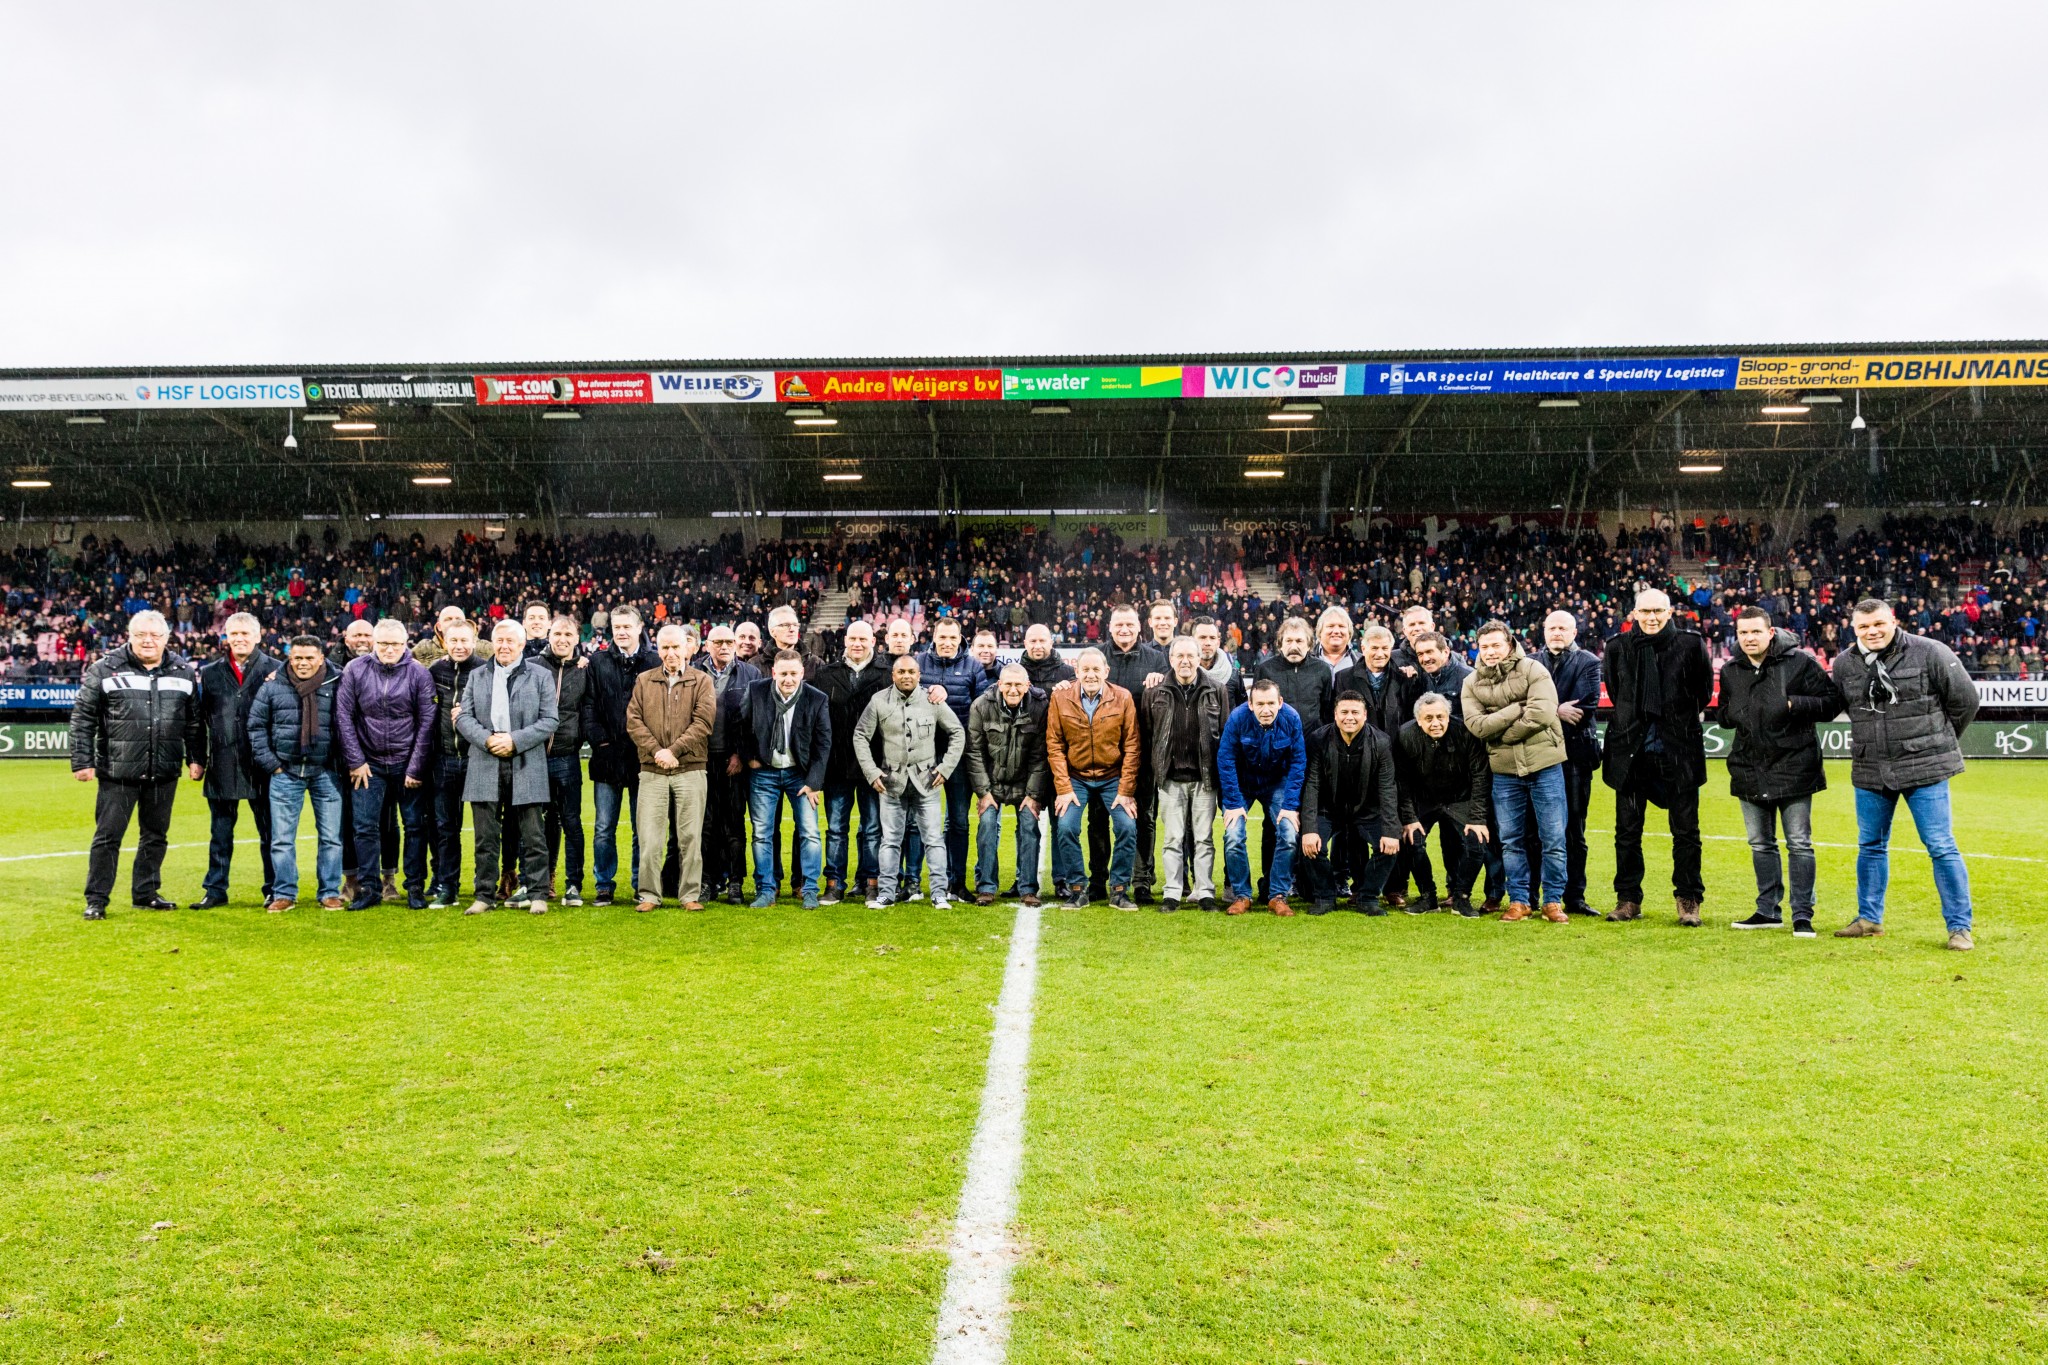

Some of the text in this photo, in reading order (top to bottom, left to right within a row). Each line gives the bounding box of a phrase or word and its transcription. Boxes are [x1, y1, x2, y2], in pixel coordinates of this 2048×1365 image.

[1036, 373, 1090, 390] water
[1503, 369, 1579, 381] Healthcare
[1584, 369, 1595, 380] &
[1599, 368, 1662, 381] Specialty
[1665, 367, 1726, 380] Logistics
[1738, 373, 1860, 386] asbestwerken
[493, 380, 555, 394] WE-COM
[658, 375, 749, 390] WEIJERS
[824, 375, 999, 397] Andre Weijers bv
[158, 384, 300, 400] HSF LOGISTICS
[322, 383, 360, 399] TEXTIEL
[611, 389, 622, 398] 373
